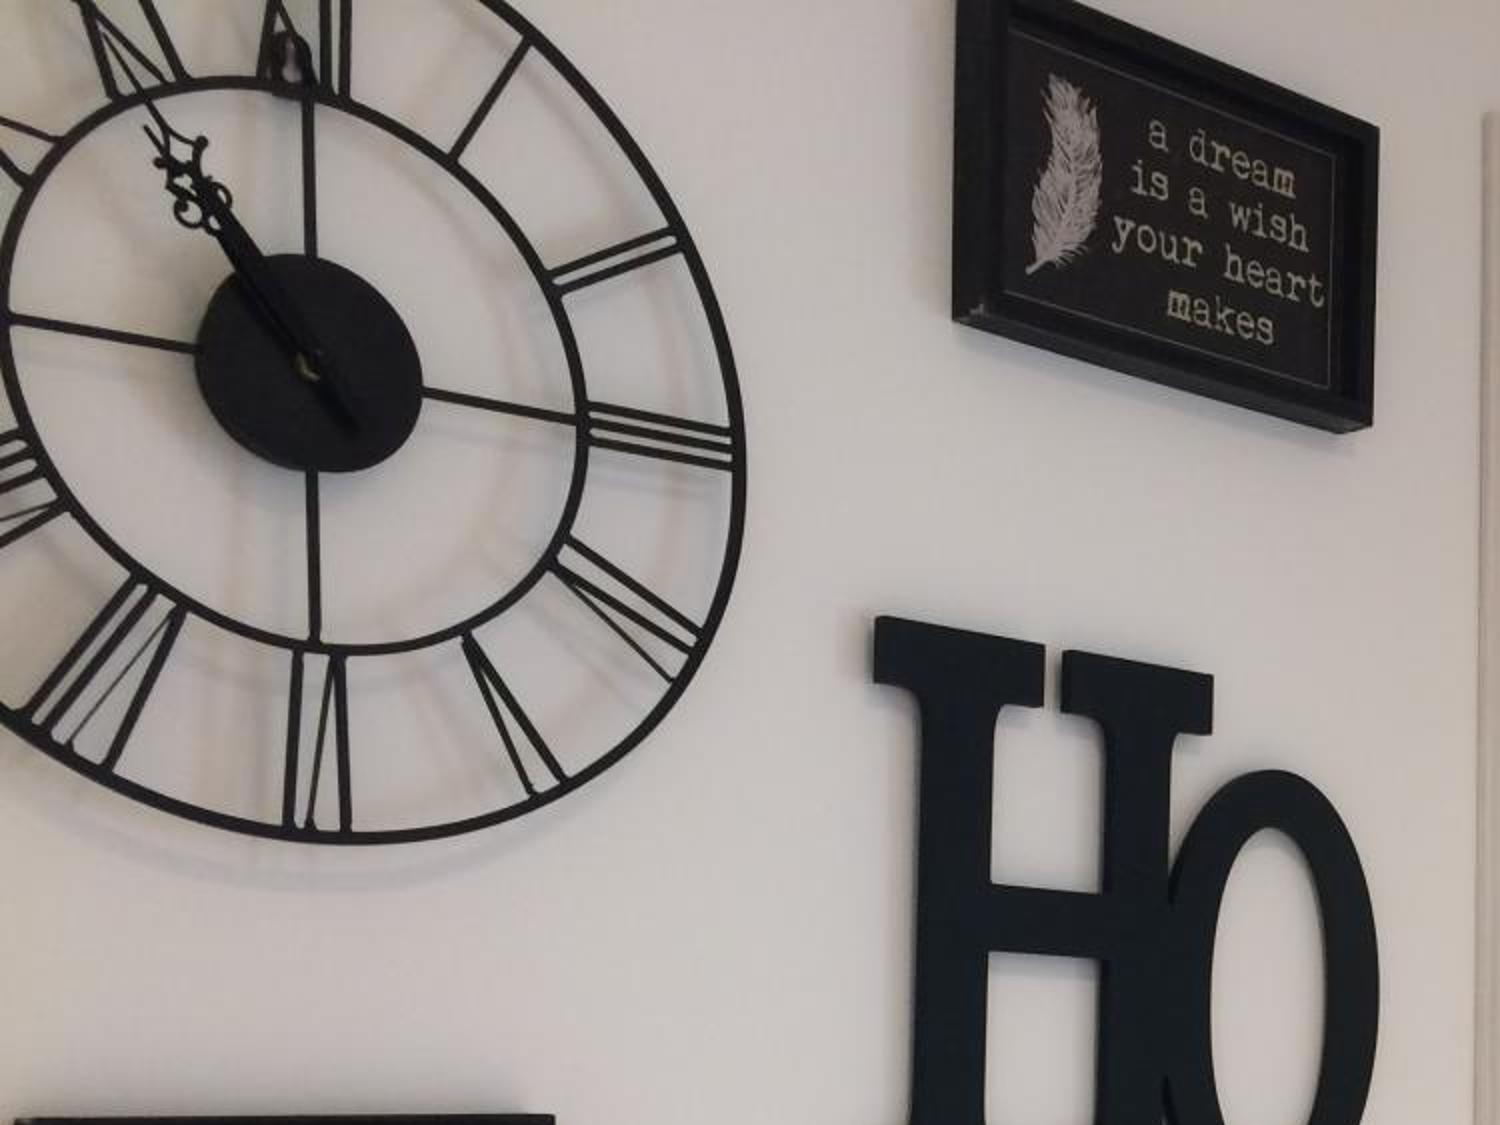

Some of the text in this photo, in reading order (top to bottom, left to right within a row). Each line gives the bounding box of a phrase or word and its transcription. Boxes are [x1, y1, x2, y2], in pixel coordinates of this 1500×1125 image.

[1149, 119, 1297, 199] a dream
[1131, 160, 1309, 253] is a wish
[1111, 215, 1325, 308] your heart
[1166, 289, 1275, 346] makes
